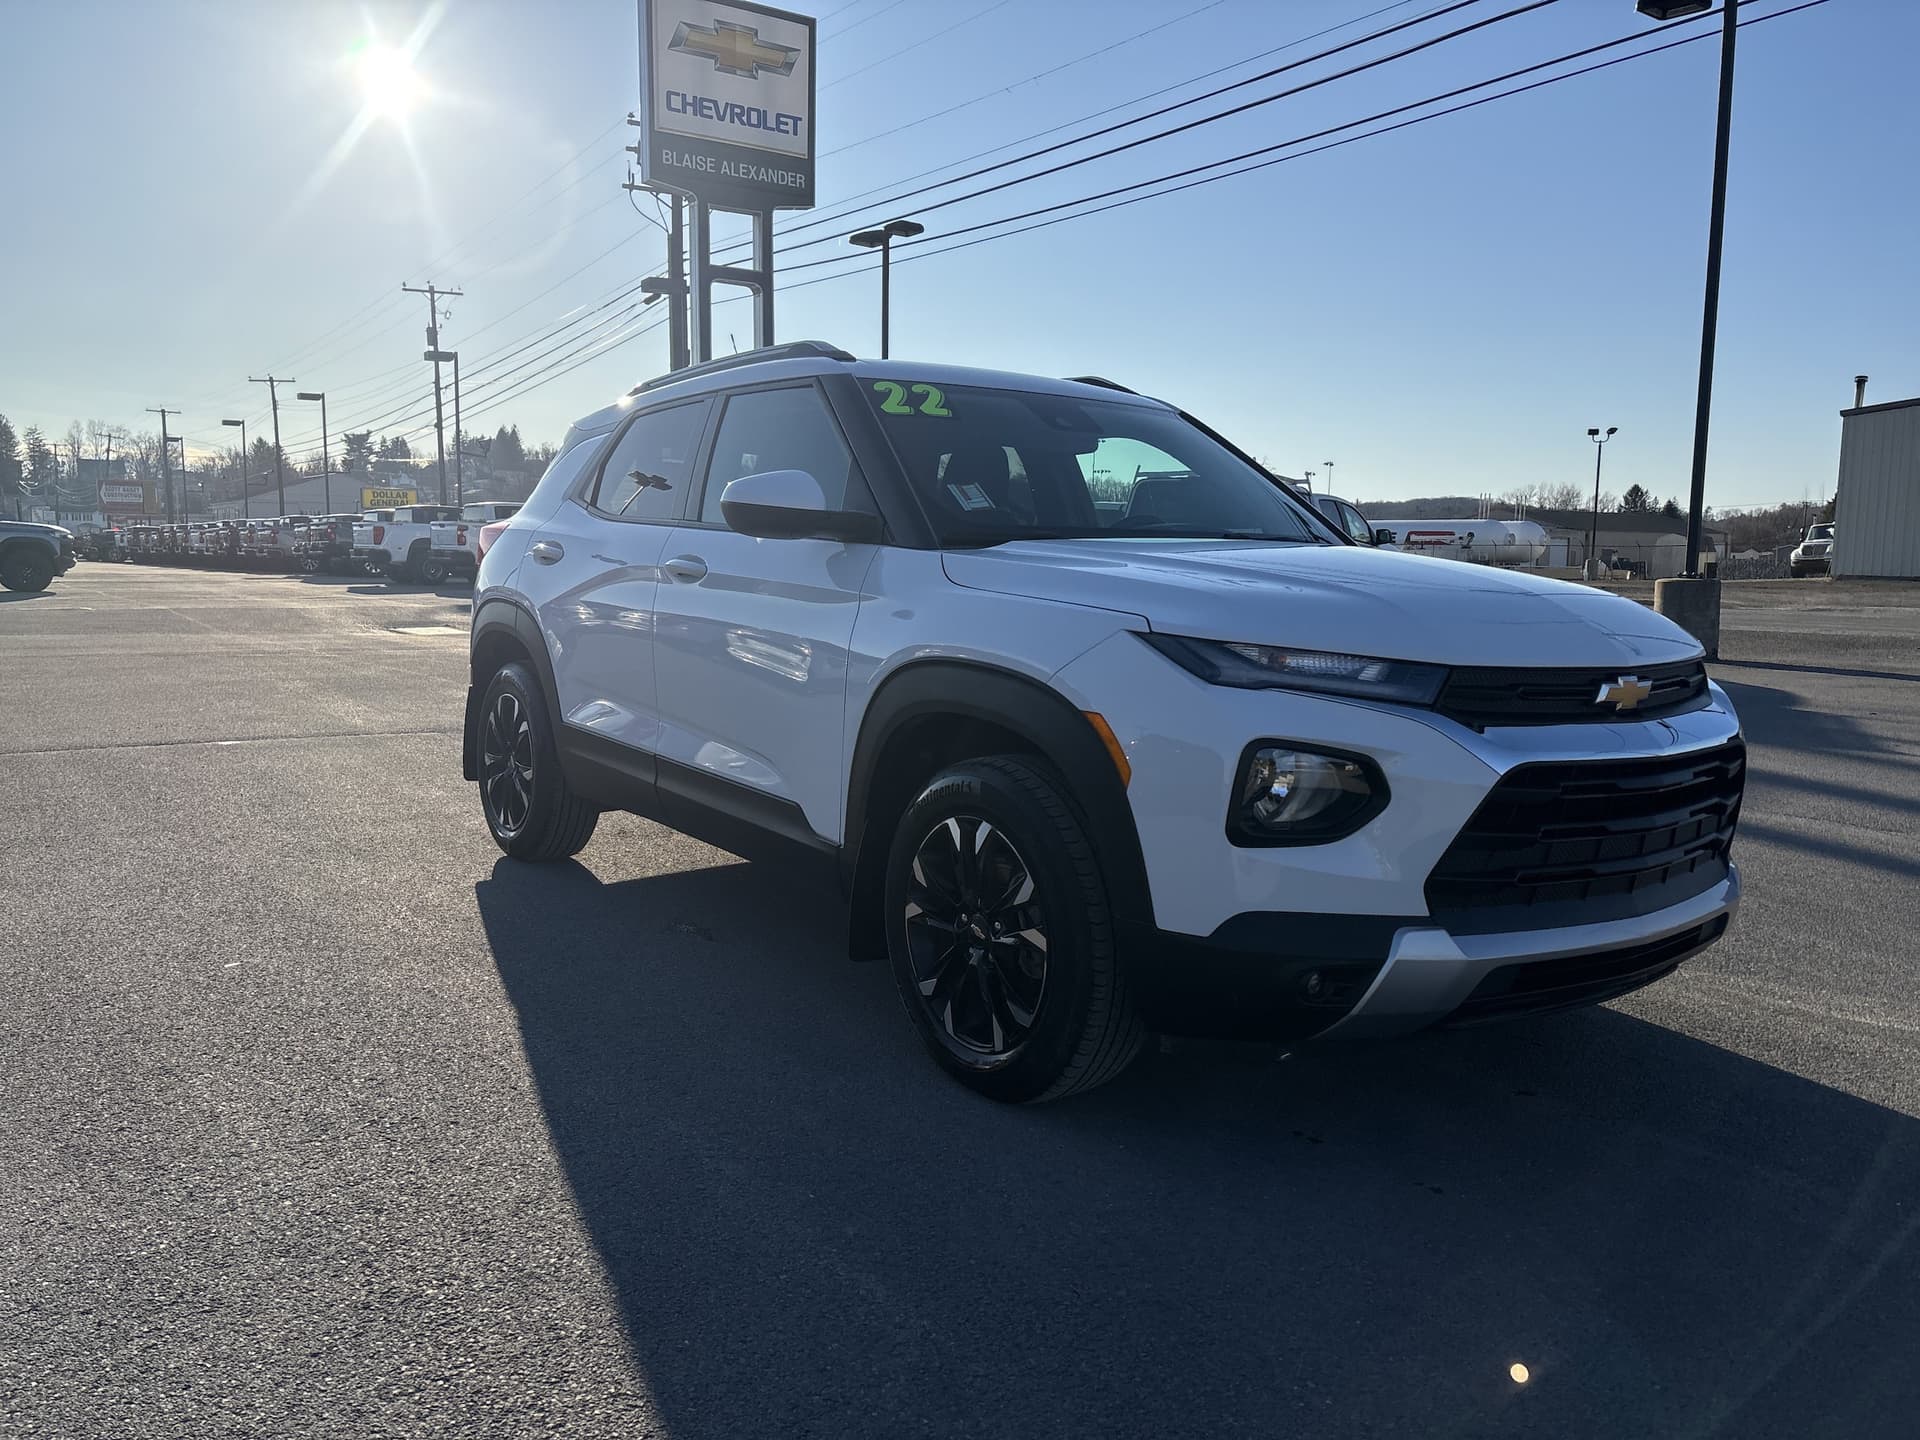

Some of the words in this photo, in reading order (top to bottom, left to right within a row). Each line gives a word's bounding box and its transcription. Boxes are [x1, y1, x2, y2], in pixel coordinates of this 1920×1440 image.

[666, 90, 802, 136] CHEVROLET
[662, 150, 716, 173] BLAISE
[720, 161, 805, 188] ALEXANDER
[873, 381, 952, 417] 22
[372, 491, 408, 499] DOLLAR
